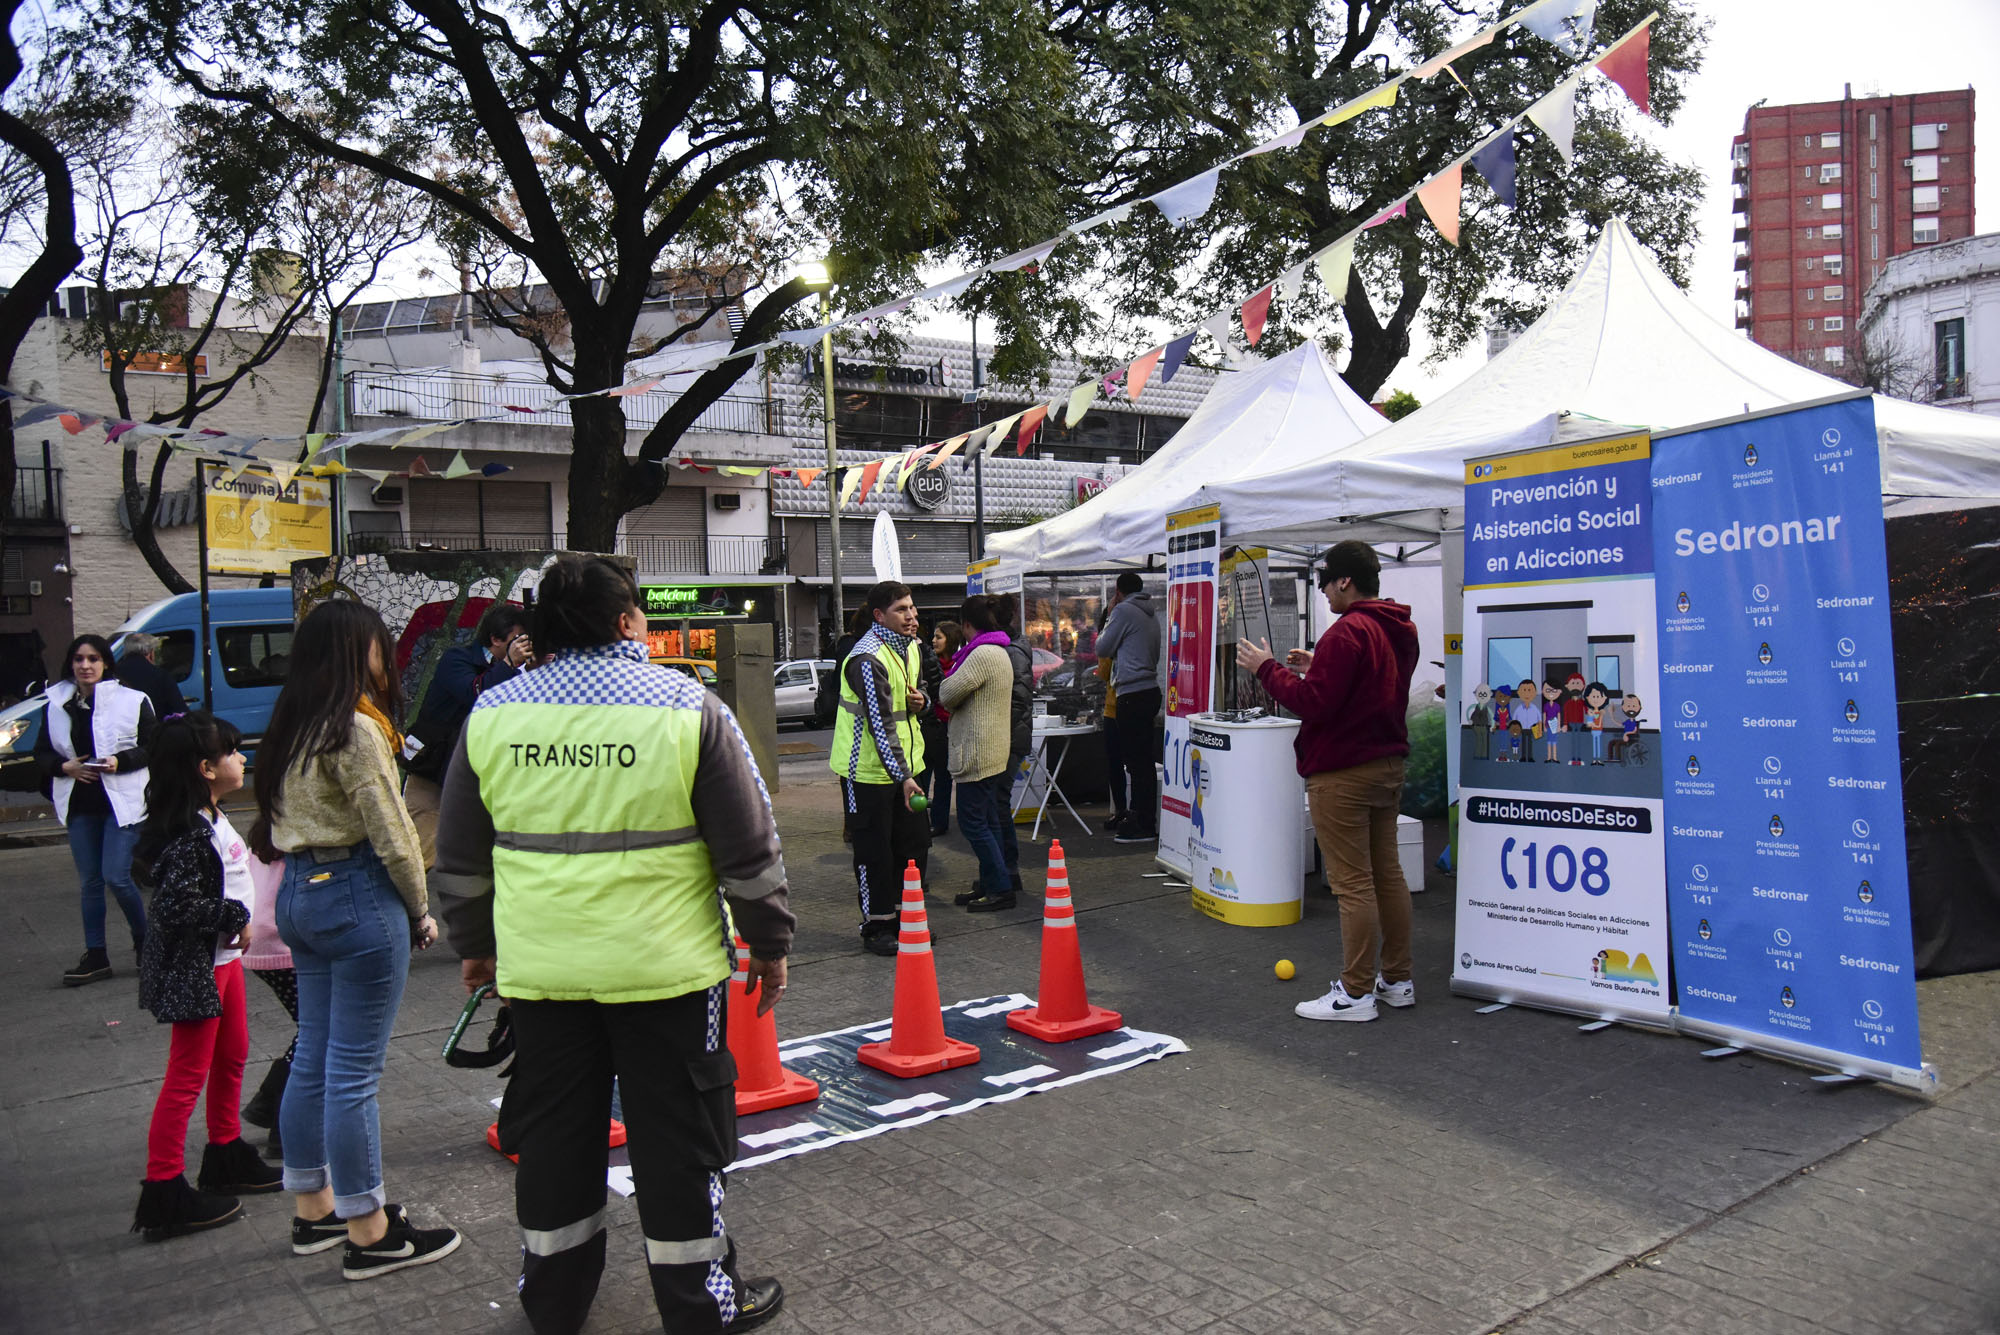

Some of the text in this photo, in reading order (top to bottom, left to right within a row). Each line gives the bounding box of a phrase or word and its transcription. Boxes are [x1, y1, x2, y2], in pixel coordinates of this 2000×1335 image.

[1572, 442, 1638, 460] buenosaires.gob.ar
[1814, 448, 1853, 462] Llamá al
[1732, 468, 1773, 481] Presidencia
[1822, 461, 1844, 475] 141
[212, 476, 275, 496] Comuna
[1652, 471, 1702, 488] Sedronar
[1733, 480, 1742, 488] de
[1749, 476, 1774, 486] Nación
[1491, 476, 1617, 507] Prevención y
[1472, 503, 1641, 541] Asistencia Social
[1675, 514, 1841, 557] Sedronar
[1486, 546, 1624, 572] en Adicciones
[646, 588, 698, 601] beldent
[1816, 595, 1874, 609] Sedronar
[1745, 604, 1779, 614] Llamá al
[1665, 617, 1705, 625] Presidencia
[1753, 616, 1773, 628] 141
[1666, 625, 1674, 633] de
[1682, 623, 1705, 631] Nación
[1663, 662, 1714, 674] Sedronar
[1831, 659, 1867, 669] Llamá al
[1746, 668, 1787, 677] Presidencia
[1838, 671, 1859, 683] 141
[1756, 676, 1763, 684] la
[1764, 675, 1788, 684] Nación
[1674, 720, 1707, 728] Llamá al
[1742, 717, 1797, 728] Sedronar
[1681, 731, 1701, 742] 141
[1832, 727, 1875, 736] Presidencia
[1832, 735, 1876, 744] de la Nación
[510, 744, 636, 768] TRANSITO
[1675, 780, 1715, 789] Presidencia
[1755, 776, 1791, 786] Llamá al
[1828, 776, 1887, 790] Sedronar
[1684, 787, 1691, 795] la
[1692, 788, 1715, 796] Nación
[1763, 788, 1784, 799] 141
[1478, 801, 1637, 828] #HablemosDeEsto
[1672, 825, 1724, 839] Sedronar
[1756, 840, 1799, 850] Presidencia
[1843, 840, 1880, 851] Llamá al
[1766, 848, 1773, 856] la
[1774, 848, 1800, 858] Nación
[1852, 852, 1874, 864] 141
[1522, 842, 1611, 896] 108
[1685, 883, 1719, 893] Llamá al
[1752, 886, 1809, 902] Sedronar
[1692, 894, 1712, 905] 141
[1468, 899, 1498, 909] Dirección
[1500, 902, 1525, 912] General
[1526, 905, 1535, 913] de
[1537, 907, 1566, 917] Políticas
[1567, 910, 1597, 921] Sociales
[1610, 914, 1650, 927] Adicciones
[1843, 906, 1889, 918] Presidencia
[1487, 912, 1517, 922] Ministerio
[1519, 915, 1528, 923] de
[1529, 916, 1564, 927] Desarrollo
[1565, 921, 1594, 931] Humano
[1602, 926, 1628, 935] Hábitat
[1843, 914, 1890, 927] de la Nación
[1687, 942, 1727, 953] Presidencia
[1766, 947, 1802, 960] Llamá al
[1704, 951, 1727, 961] Nación
[1473, 959, 1536, 975] Buenos Aires Ciudad
[1774, 959, 1795, 971] 141
[1839, 954, 1900, 974] Sedronar
[1590, 980, 1660, 997] Vamos Buenos Aires
[1686, 985, 1737, 1003] Sedronar
[1768, 1009, 1811, 1023] Presidencia
[1769, 1016, 1811, 1031] de la Nación
[1854, 1018, 1894, 1033] Llamá al
[1863, 1032, 1886, 1046] 141
